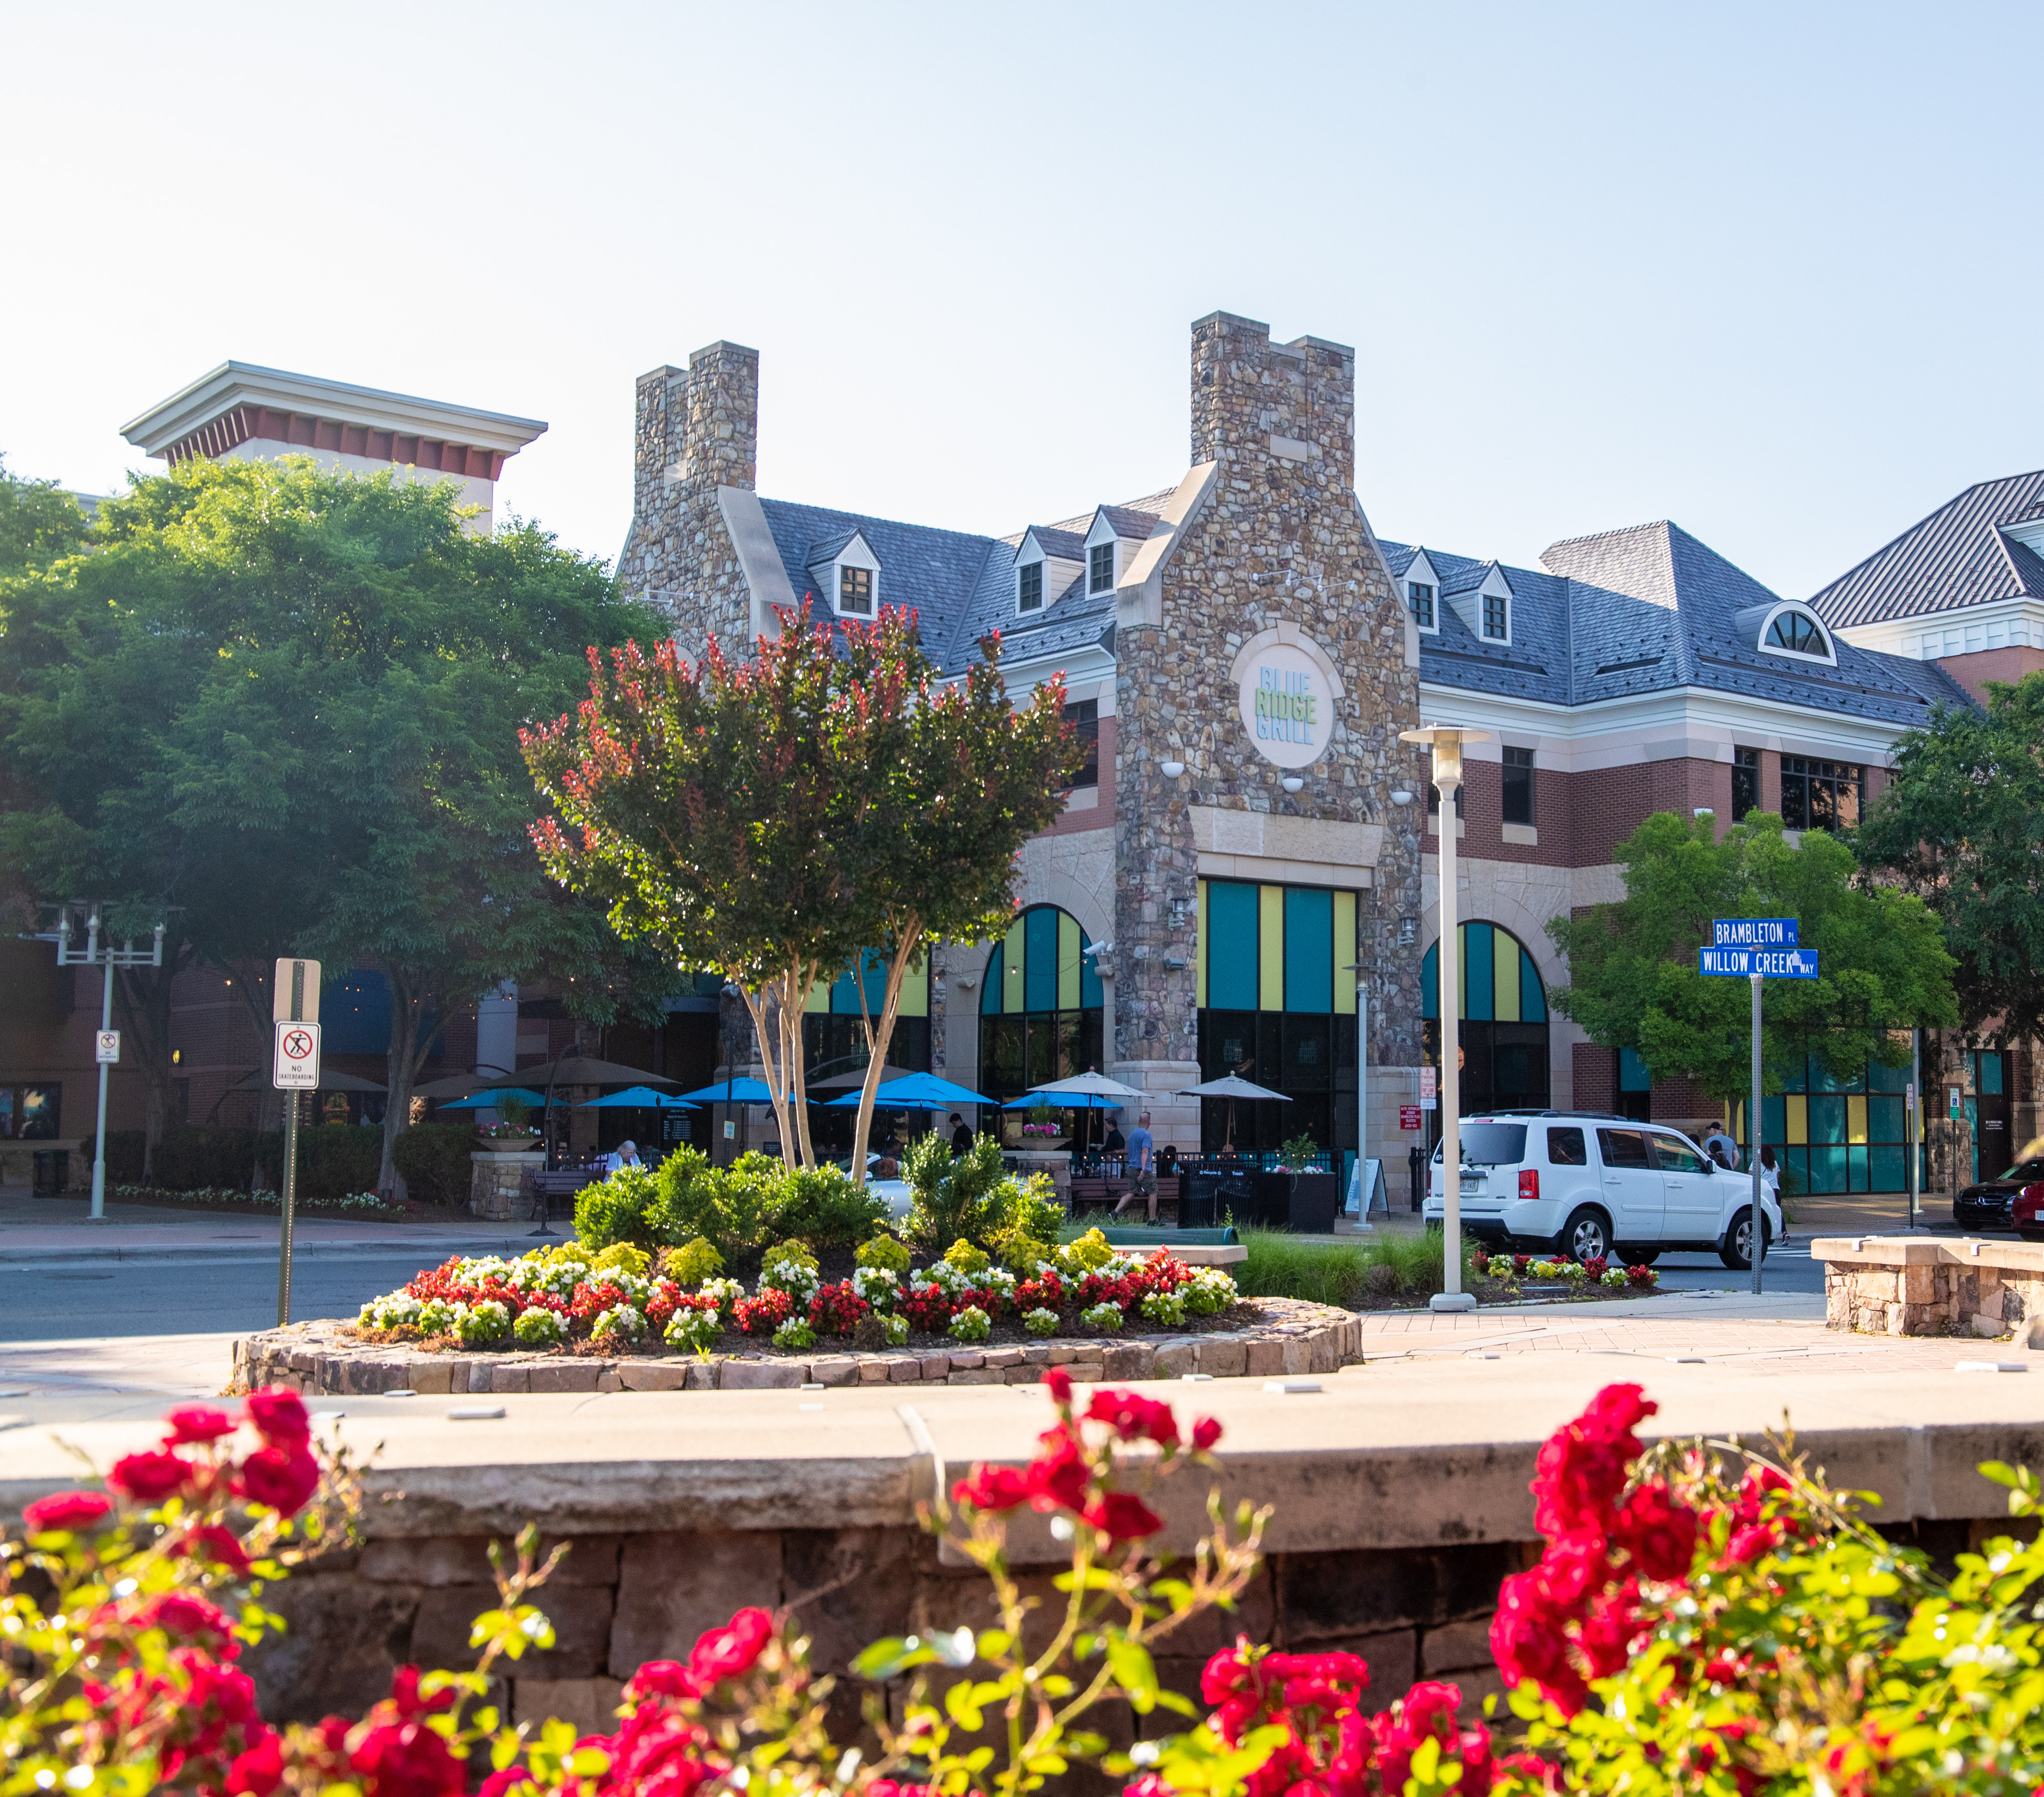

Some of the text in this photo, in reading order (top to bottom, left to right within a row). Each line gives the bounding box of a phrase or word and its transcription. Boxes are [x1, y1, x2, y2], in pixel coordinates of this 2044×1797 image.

[1261, 667, 1310, 699] BLUE
[1256, 687, 1317, 724] RIDGE
[1257, 711, 1314, 745] GRILL
[1717, 923, 1795, 944] BRAMBLETON PL
[1704, 951, 1814, 974] WILLOW CREEK WAY
